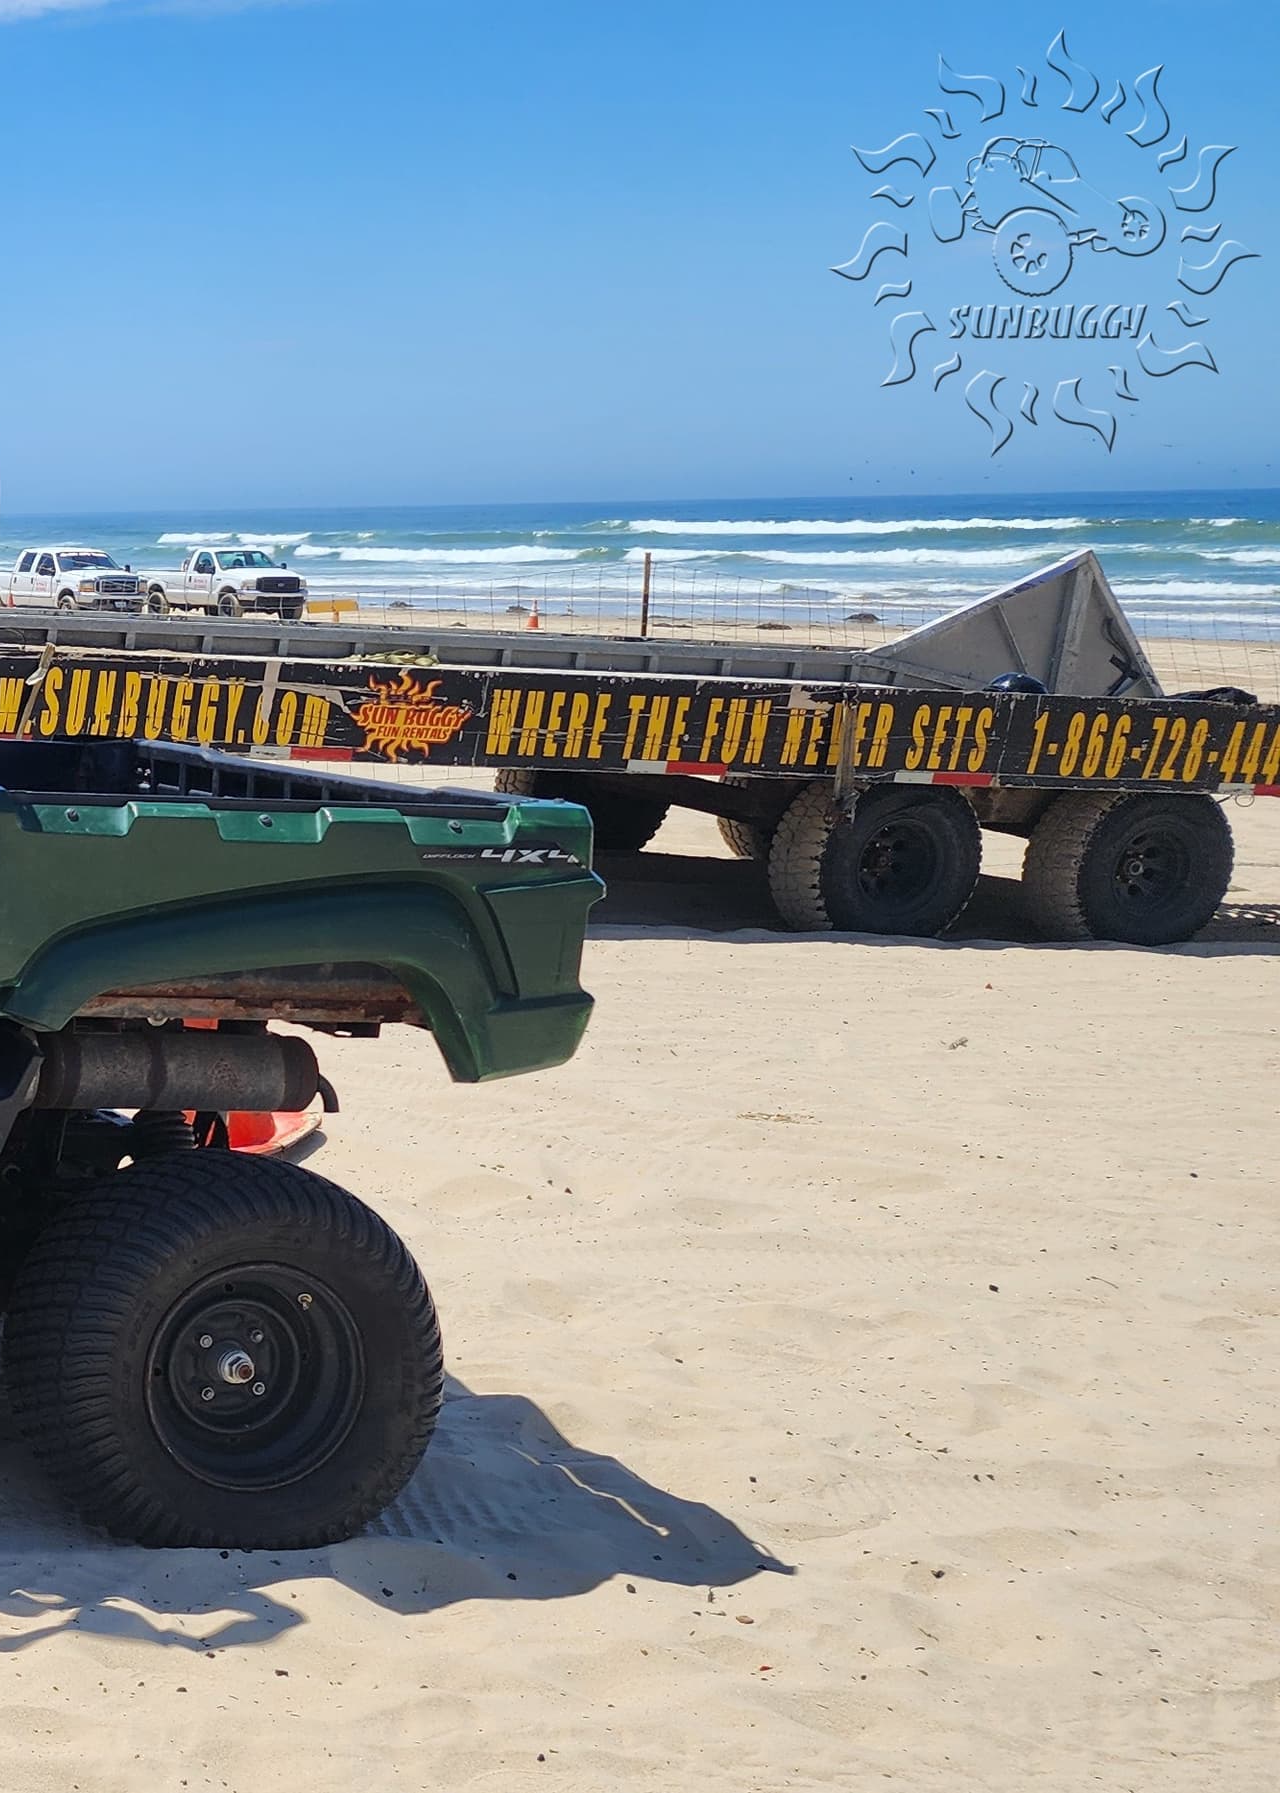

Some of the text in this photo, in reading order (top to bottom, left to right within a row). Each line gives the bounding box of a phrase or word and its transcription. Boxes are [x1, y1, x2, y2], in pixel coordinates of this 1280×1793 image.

[359, 703, 468, 729] SUN BUGGY
[375, 725, 450, 740] FUN RENTALS
[485, 689, 612, 759] WHERE
[622, 695, 692, 761] THE
[699, 697, 772, 764] FUN
[779, 701, 894, 768] NEVER
[904, 704, 994, 773] SETS
